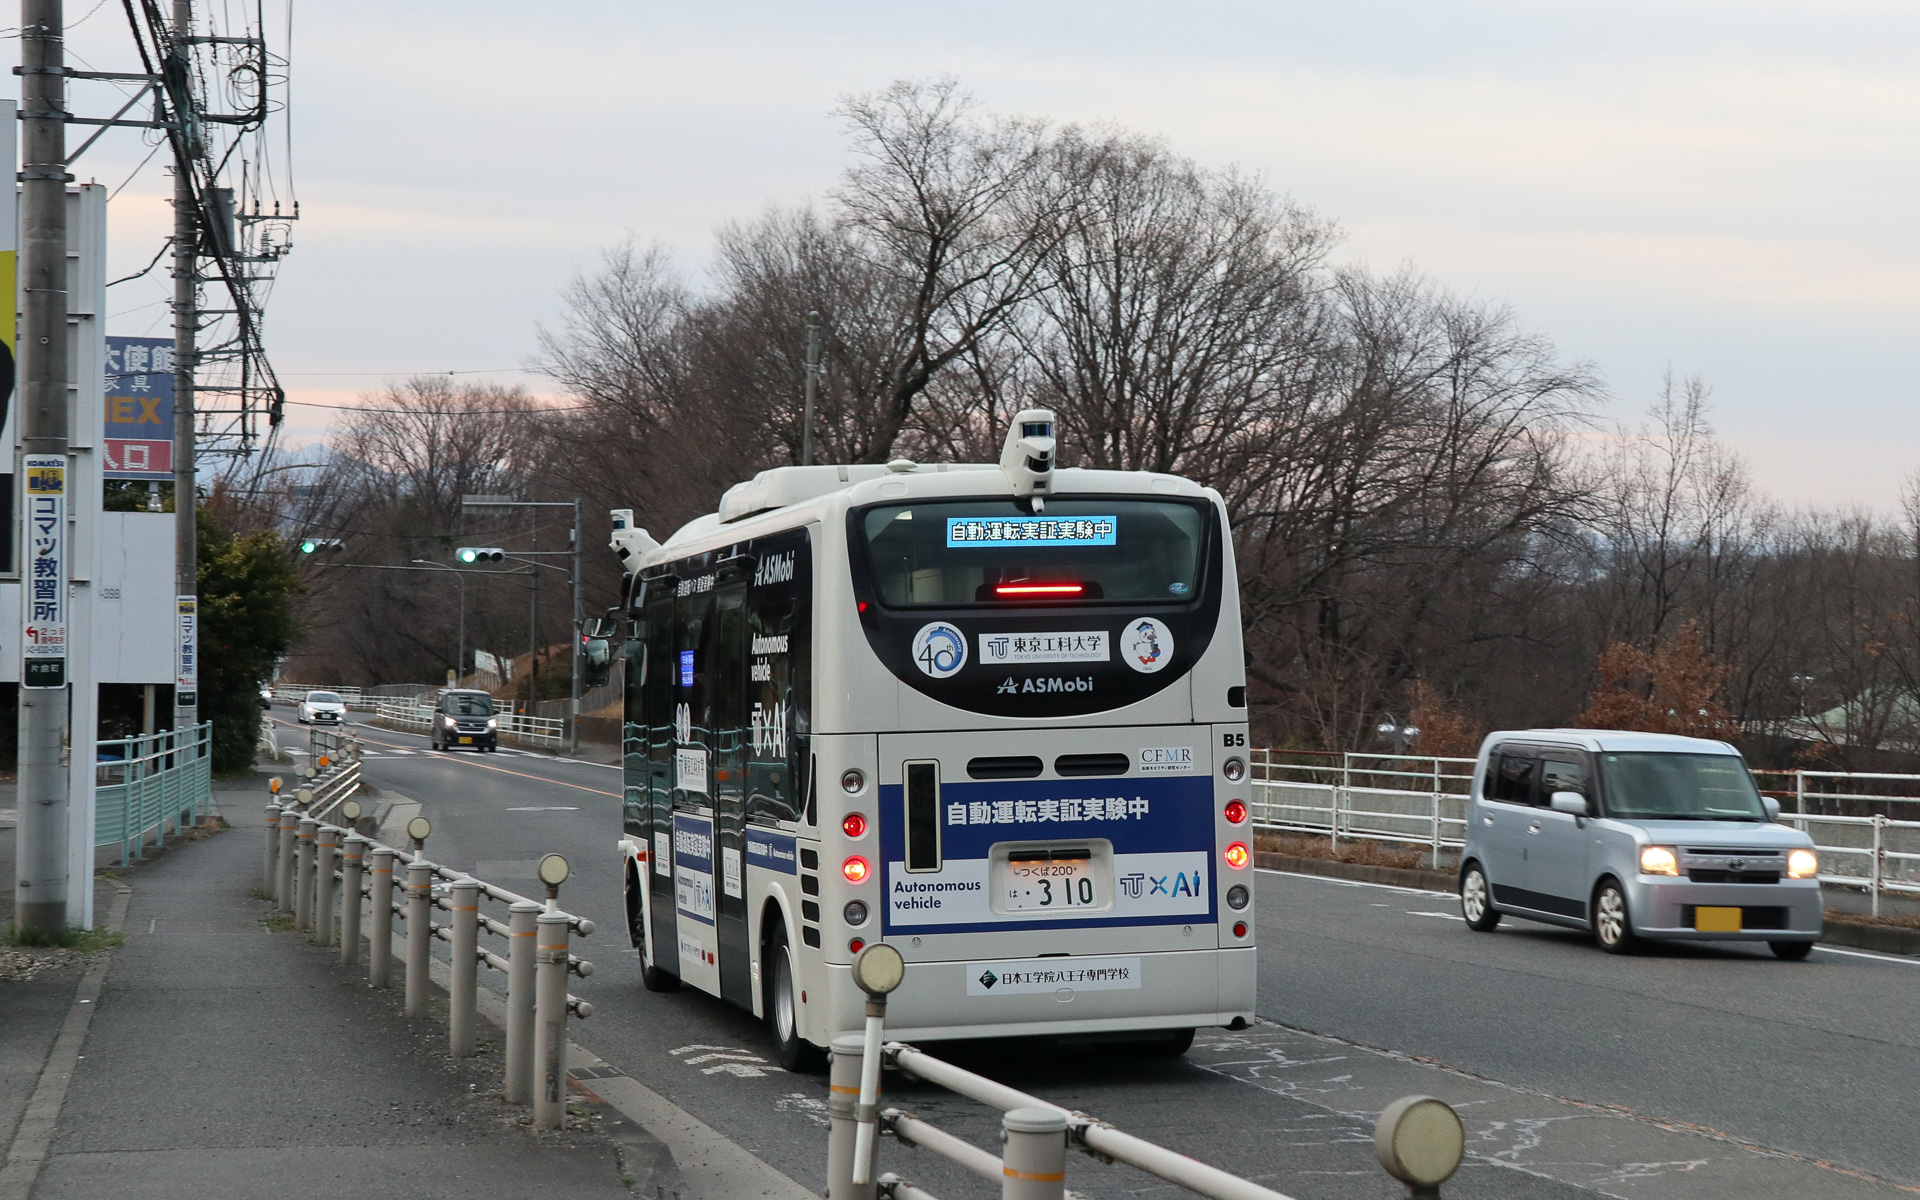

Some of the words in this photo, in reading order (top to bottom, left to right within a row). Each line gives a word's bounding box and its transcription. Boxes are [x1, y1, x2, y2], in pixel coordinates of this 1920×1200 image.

[951, 520, 1113, 541] 自動運転実証実験中
[34, 497, 58, 621] コマツ教習所
[763, 550, 795, 585] ASMobi
[751, 632, 789, 654] Autonomous
[1013, 635, 1101, 653] 東京工科大学
[751, 656, 771, 681] vehicle
[1021, 676, 1094, 693] ASMobi
[1223, 733, 1245, 747] B5
[1141, 748, 1192, 763] CFMR
[948, 796, 1149, 826] 自動運転実証実験中
[1020, 866, 1050, 877] つくば
[1052, 866, 1074, 876] 200
[894, 881, 981, 893] Autonomous
[1009, 889, 1018, 898] は
[894, 895, 942, 909] vehicle
[1002, 967, 1130, 985] 日本工学院八王子専門学校
